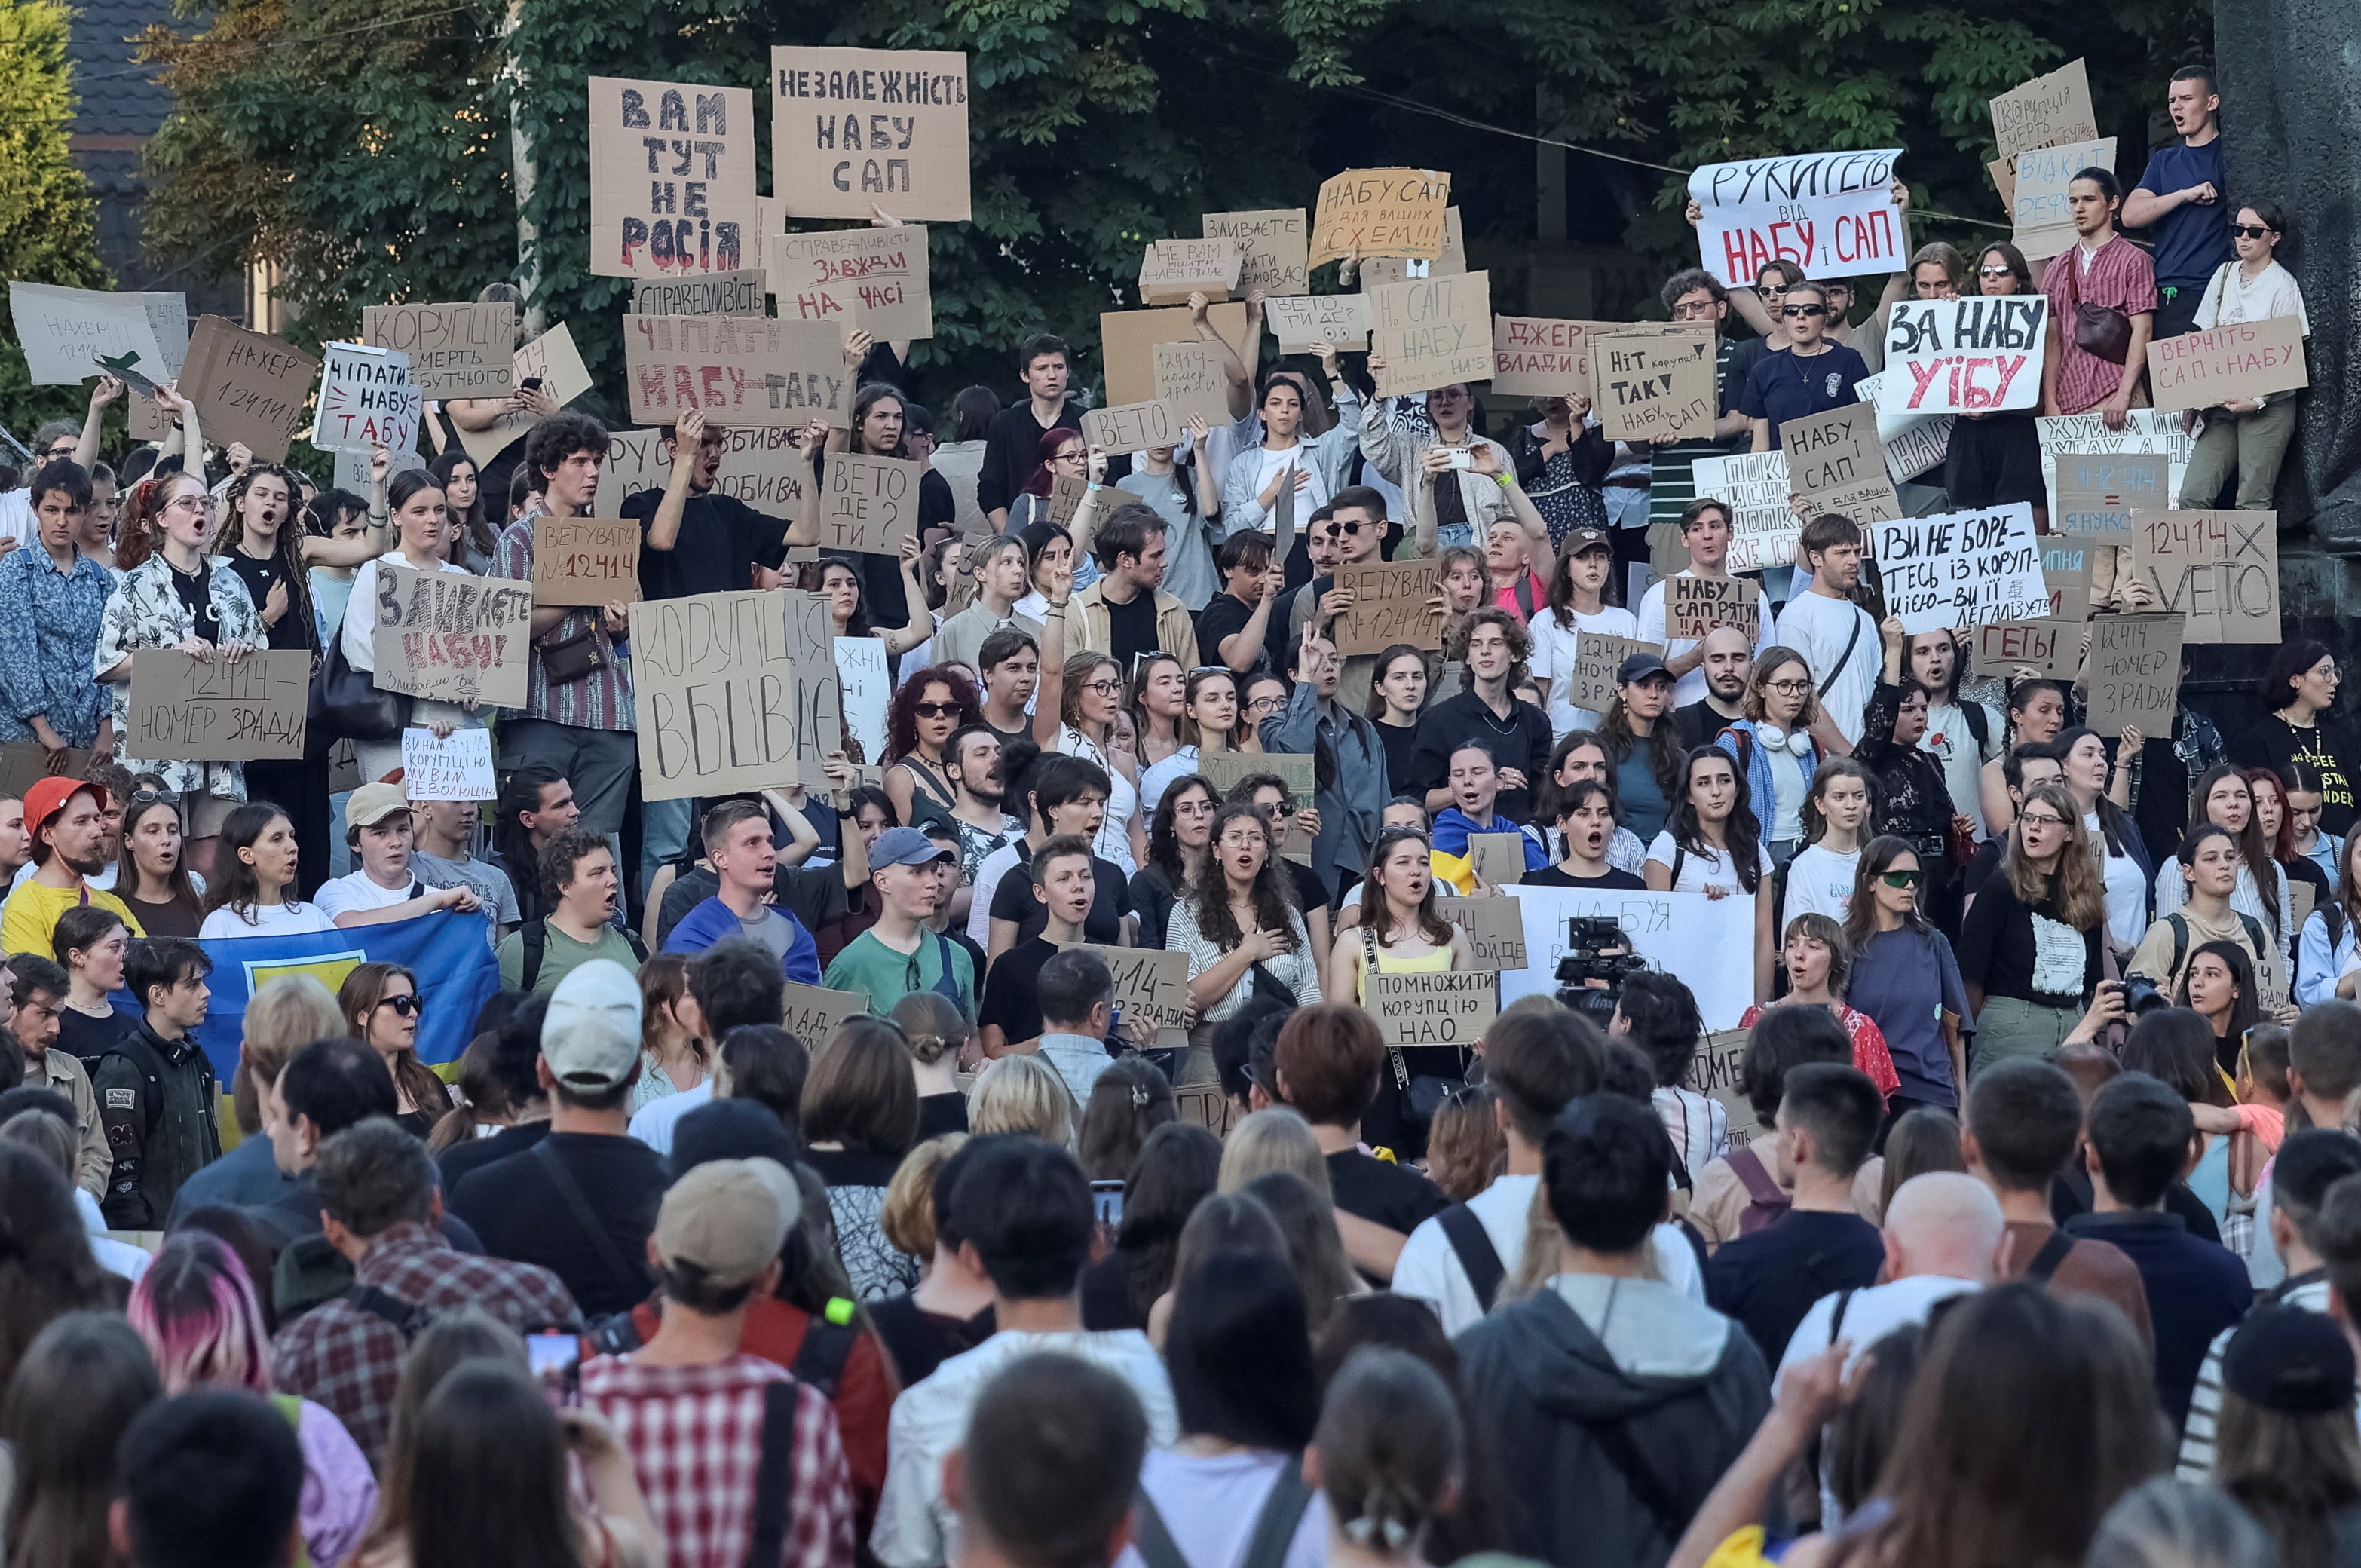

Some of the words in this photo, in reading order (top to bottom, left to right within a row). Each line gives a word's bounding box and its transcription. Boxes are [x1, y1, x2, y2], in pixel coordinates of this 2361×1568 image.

[779, 69, 966, 106] НЕЗАЛЕЖНІСТЬ
[622, 87, 727, 136] ВАМ
[816, 113, 915, 151] НАБУ
[642, 136, 726, 180] ТУТ
[833, 158, 910, 193] САП
[1324, 179, 1395, 213] НАБУ
[1400, 180, 1448, 203] САП
[1712, 155, 1817, 207] РУКИ
[651, 181, 709, 219] НЕ
[1340, 210, 1369, 223] ДЛЯ
[1379, 210, 1432, 222] ВАШИХ
[621, 216, 740, 270] РОСІЯ
[1208, 219, 1300, 239] ЗЛИВАЄТЕ
[1722, 220, 1814, 284] НАБУ
[1835, 210, 1894, 263] САП
[813, 251, 907, 283] ЗАВЖДИ
[1187, 243, 1220, 261] ВАМ
[797, 291, 843, 320] НА
[858, 281, 905, 311] ЧАСІ
[1407, 279, 1452, 323] САП
[373, 305, 512, 350] КОРУПЦІЯ
[638, 318, 781, 355] ЧІПАТИ
[1283, 312, 1312, 328] ТИ
[1891, 305, 1943, 354] ЗА
[1954, 299, 2046, 351] НАБУ
[226, 339, 298, 378] НАХЕР
[409, 349, 482, 369] МЕРТЬ
[1404, 323, 1467, 363] НАБУ
[2161, 326, 2255, 362] ВЕРНІТЬ
[1497, 352, 1572, 374] ВЛАДИ
[2158, 360, 2206, 389] САП
[2228, 344, 2293, 375] НАБУ
[360, 387, 409, 412] НАБУ
[1610, 373, 1672, 406] ТАК!
[1907, 355, 2026, 409] УЇБУ
[338, 414, 408, 450] ТАБУ
[1098, 404, 1168, 446] ВЕТО
[1622, 405, 1661, 432] НАБУ
[1668, 398, 1708, 431] САП
[1791, 419, 1853, 455] НАБУ
[834, 461, 907, 501] ВЕТО
[1805, 457, 1856, 490] САП
[833, 497, 868, 519] ДЕ
[544, 527, 635, 549] ВЕТУВАТИ
[831, 523, 865, 547] ТИ
[1883, 525, 1919, 561] ВИ
[1926, 523, 1955, 557] НЕ
[2144, 519, 2228, 559] 12414
[1343, 568, 1441, 602] ВЕТУВАТИ
[1677, 578, 1729, 601] НАБУ
[1882, 562, 1939, 594] ТЕСЬ
[2149, 562, 2272, 619] VETO
[1674, 602, 1713, 617] САП
[635, 597, 829, 681] КОРУПЦІЯ
[1983, 626, 2056, 671] ГЕТЬ!
[183, 659, 269, 698] 12414
[2104, 650, 2167, 677] НОМЕР
[2102, 681, 2173, 713] ЗРАДИ
[139, 706, 216, 745] НОМЕР
[227, 707, 304, 749] ЗРАДИ
[652, 675, 833, 779] ВБИВАЄ
[407, 767, 426, 780] МИ
[430, 767, 467, 784] ВАМ
[409, 752, 486, 769] КОРУПЦІЮ
[407, 779, 496, 798] РЕВОЛЮЦІЮ
[1378, 972, 1494, 994] ПОМНОЖИТИ
[1382, 994, 1478, 1018] КОРУПЦІЮ
